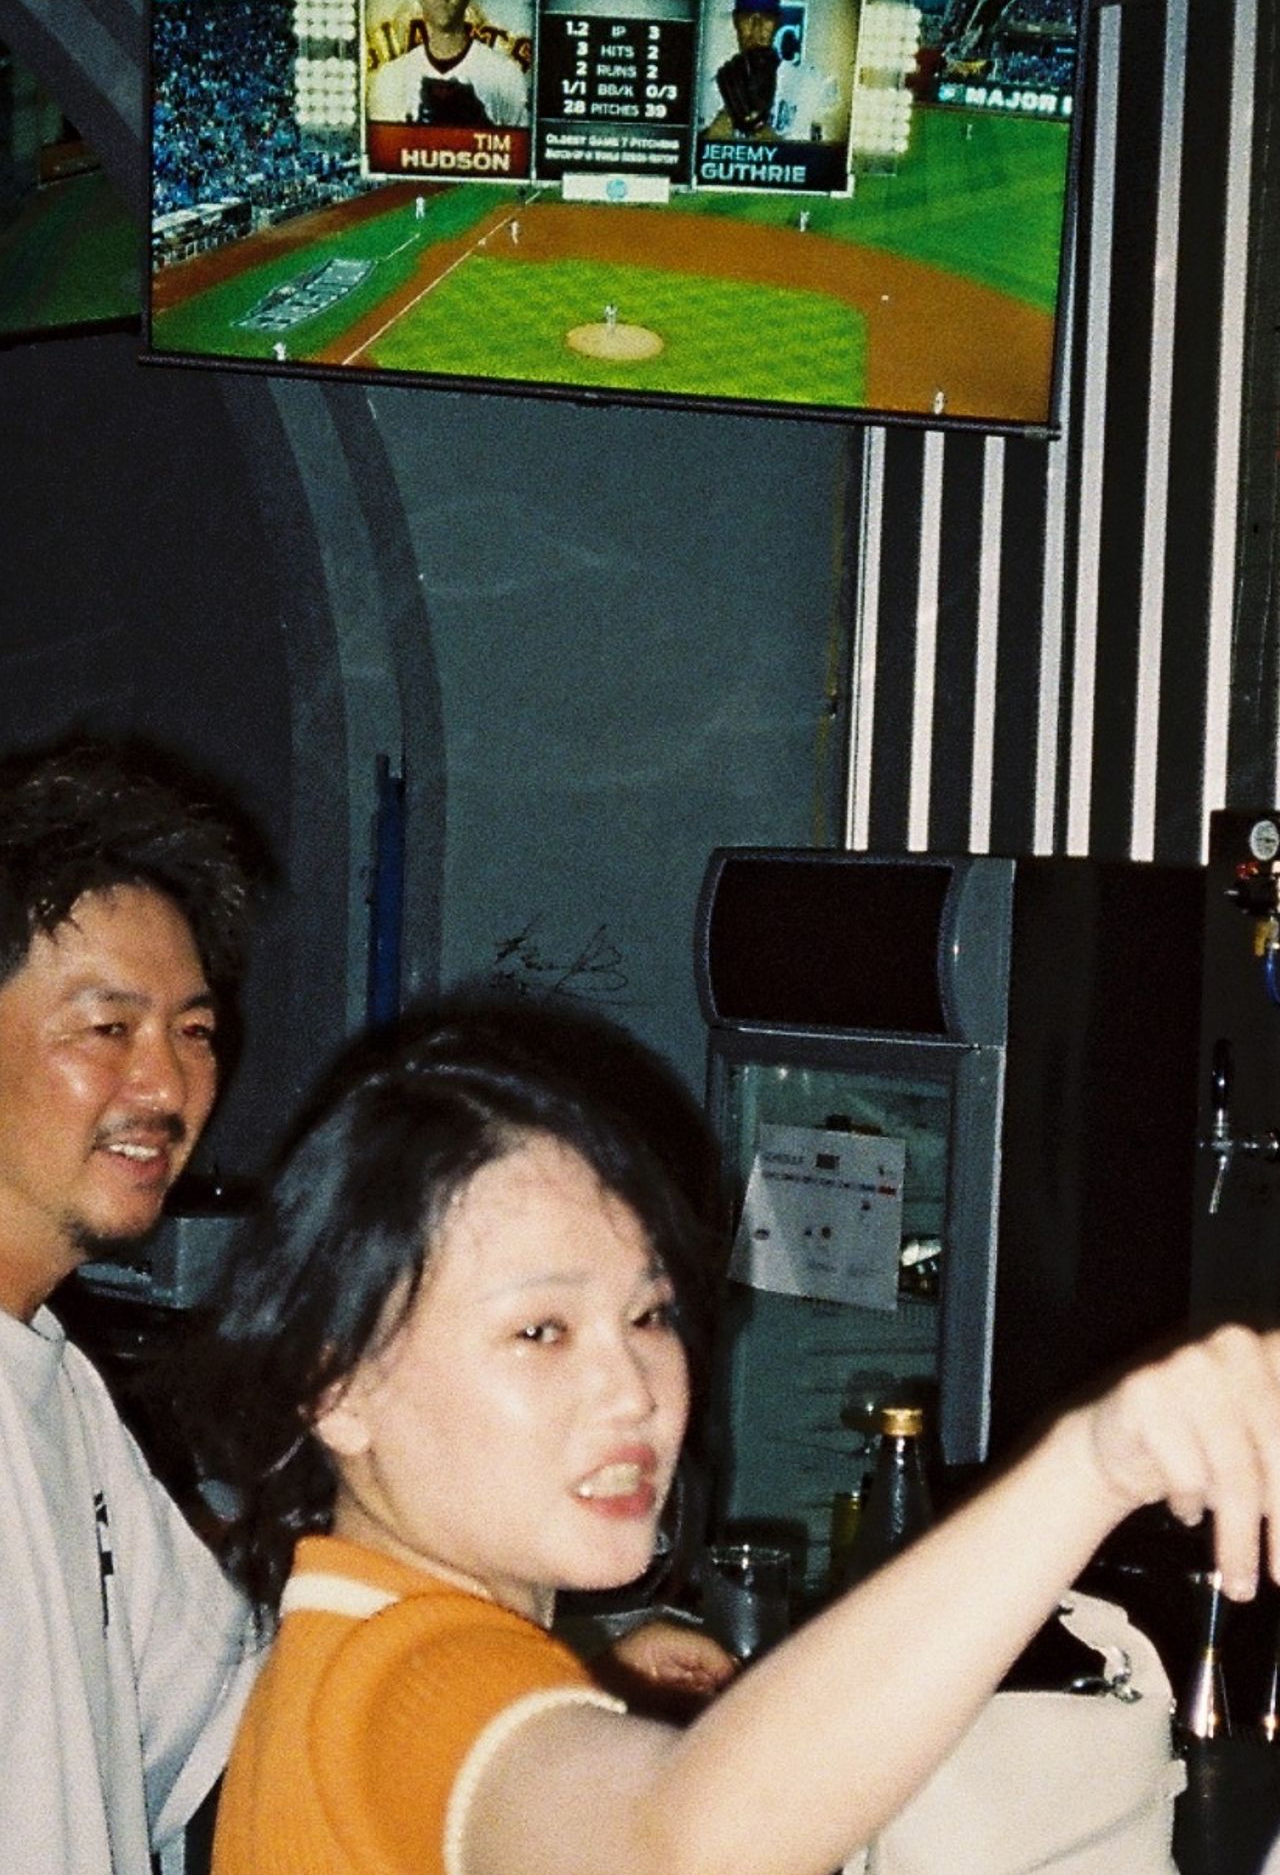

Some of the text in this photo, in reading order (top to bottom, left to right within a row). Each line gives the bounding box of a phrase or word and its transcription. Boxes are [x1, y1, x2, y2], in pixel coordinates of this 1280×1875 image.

[565, 21, 589, 37] 1.2
[648, 25, 660, 40] 3
[576, 41, 659, 60] 3 HITS 2
[576, 61, 659, 79] 2 RUNS 2
[562, 79, 677, 100] 1/1 BB/K 0/3
[564, 99, 667, 119] 28 PITCHES 39
[965, 87, 1057, 114] MAJOR
[474, 133, 511, 152] TIM
[401, 148, 510, 172] HUDSON
[702, 143, 778, 162] JEREMY
[701, 162, 806, 183] GUTHRIE
